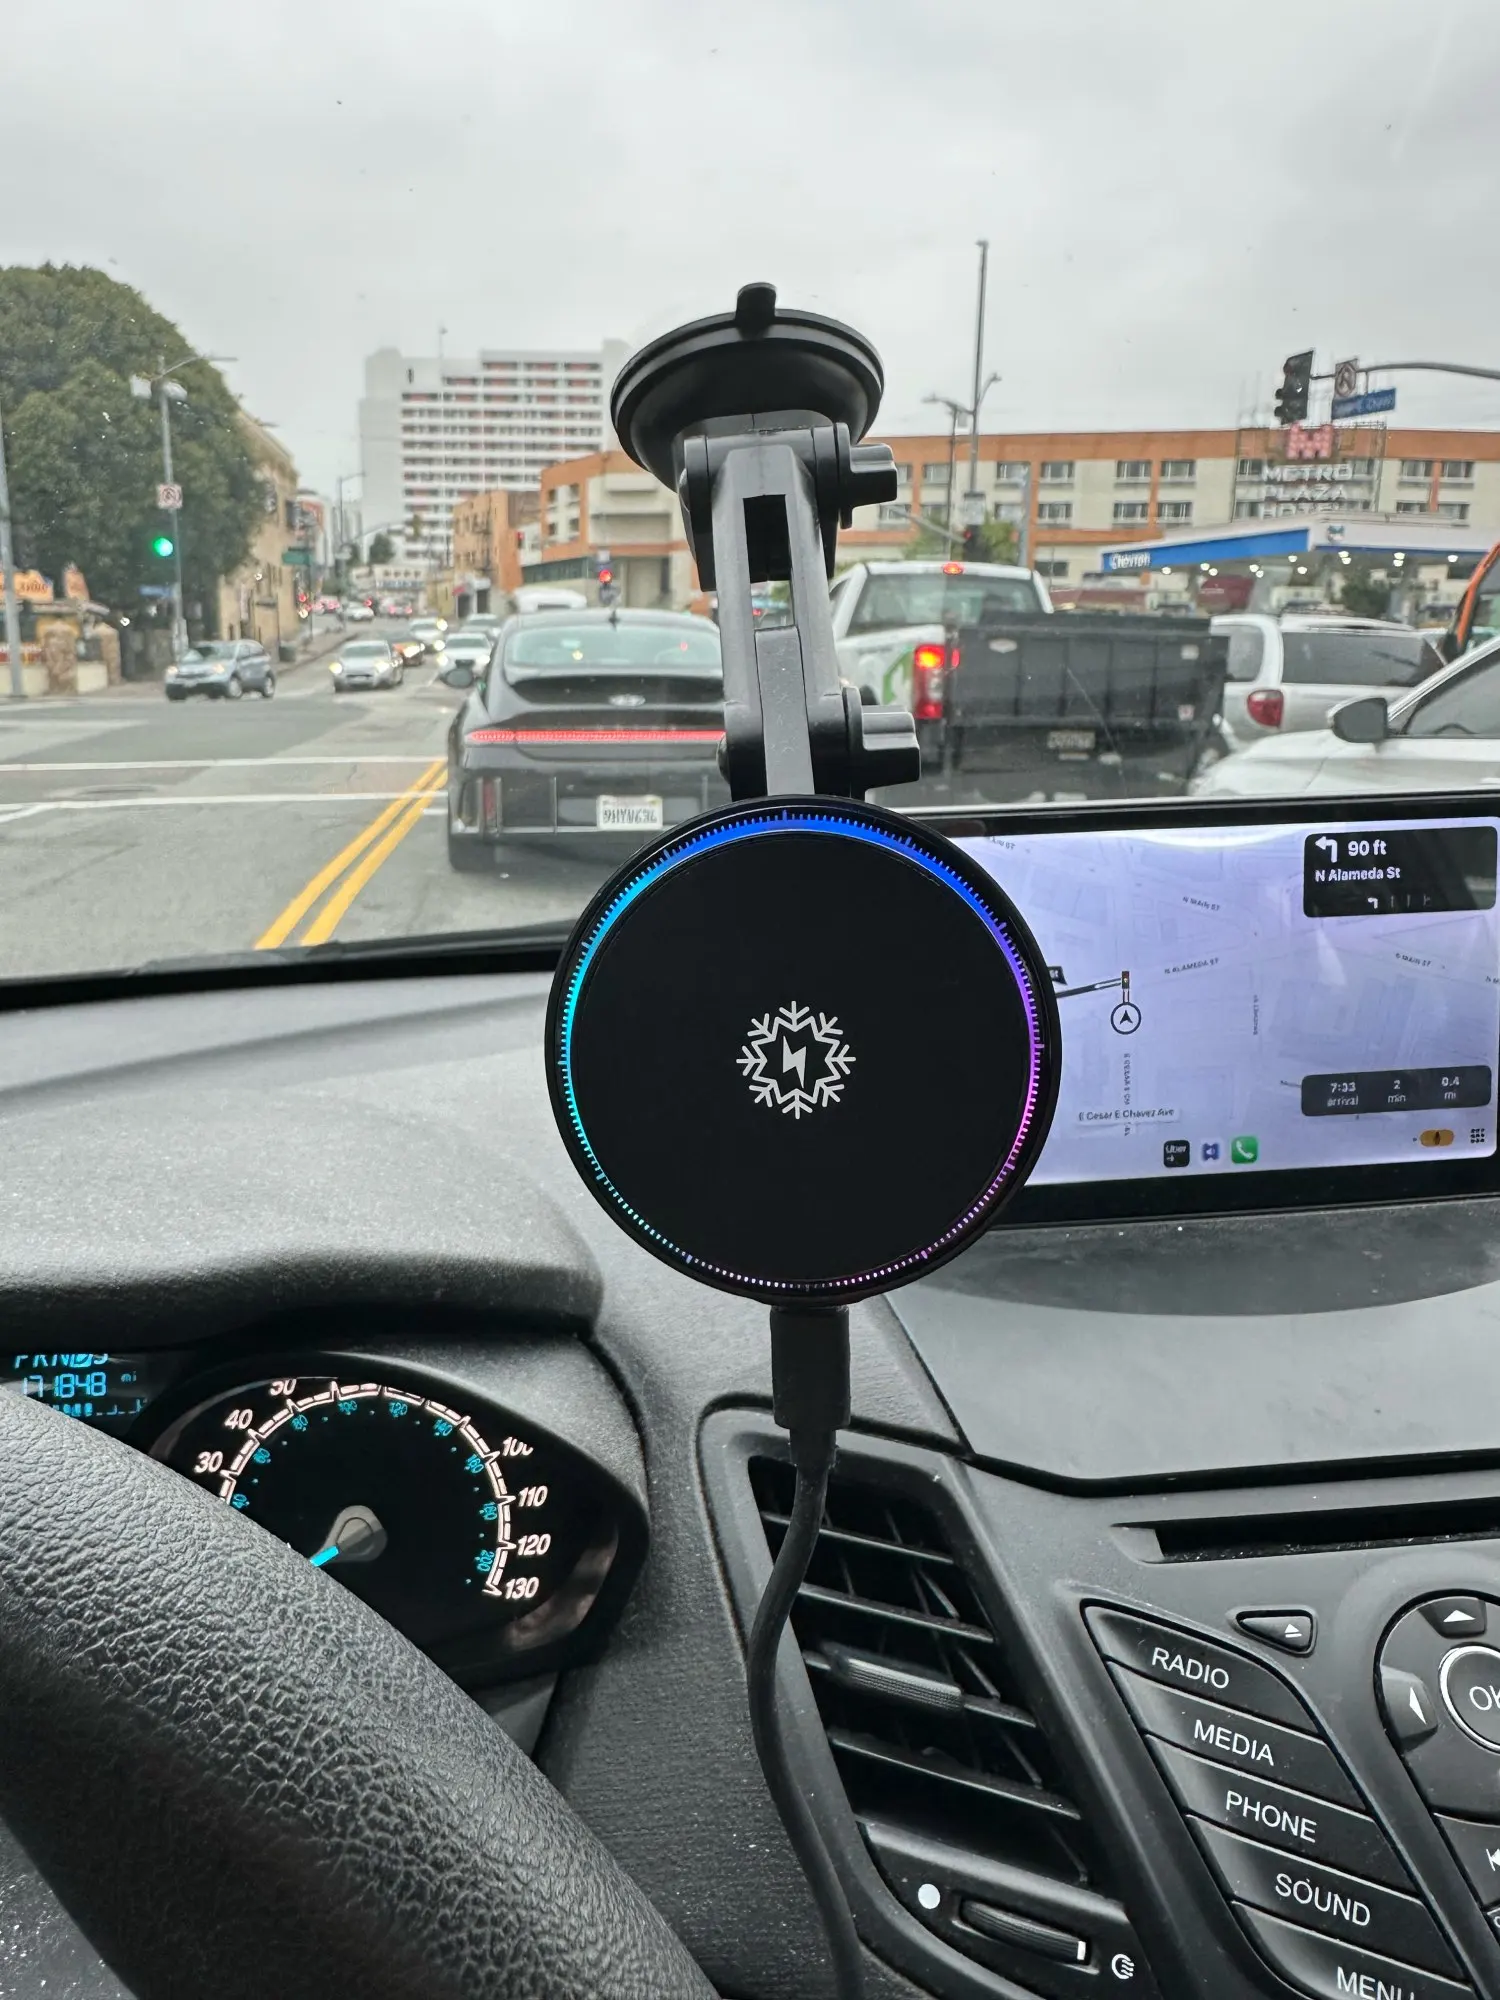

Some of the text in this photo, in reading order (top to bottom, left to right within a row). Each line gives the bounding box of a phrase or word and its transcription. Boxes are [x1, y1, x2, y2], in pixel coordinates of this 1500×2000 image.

[1347, 839, 1387, 857] 90 ft
[1315, 866, 1401, 882] N Alameda St
[1330, 1081, 1357, 1093] 7:33
[1393, 1079, 1401, 1090] 2
[1441, 1076, 1460, 1087] 0.4
[1327, 1095, 1359, 1107] arrival
[1387, 1093, 1407, 1103] min
[1444, 1090, 1457, 1100] mi
[224, 1408, 253, 1430] 40
[193, 1451, 223, 1473] 30
[518, 1485, 548, 1507] 110
[517, 1533, 552, 1556] 120
[505, 1577, 540, 1600] 130
[1151, 1647, 1230, 1689] RADIO
[1194, 1719, 1275, 1767] MEDIA
[1225, 1790, 1318, 1843] PHONE
[1274, 1873, 1371, 1927] SOUND
